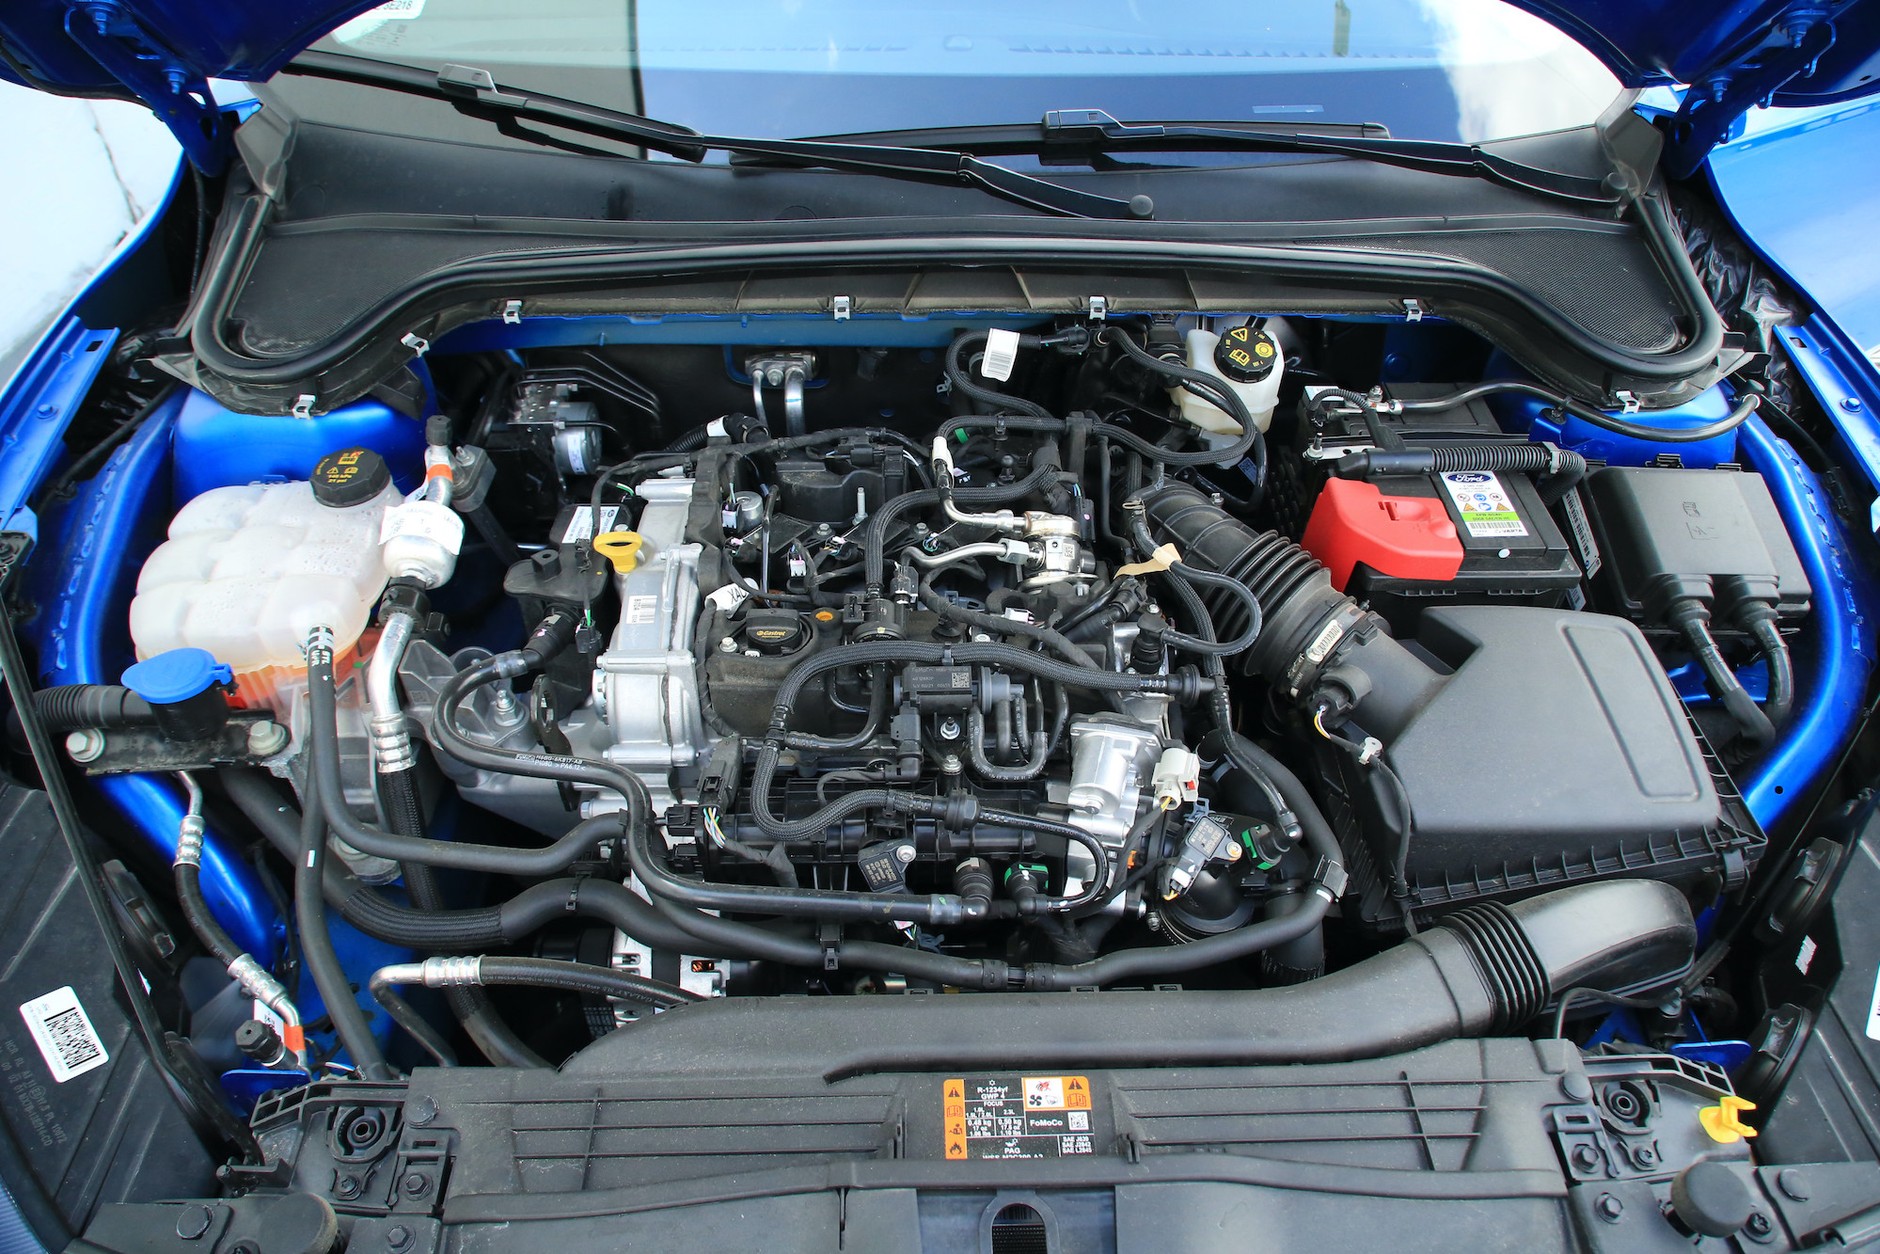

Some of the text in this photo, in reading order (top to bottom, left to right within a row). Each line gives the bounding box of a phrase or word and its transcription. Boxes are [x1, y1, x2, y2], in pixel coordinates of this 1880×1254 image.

[1455, 473, 1485, 483] Ford
[311, 649, 320, 667] UPR
[977, 1086, 1009, 1094] R-1234yf
[983, 1119, 992, 1127] kg
[1013, 1118, 1022, 1126] kg
[1029, 1118, 1063, 1127] FoMoCo
